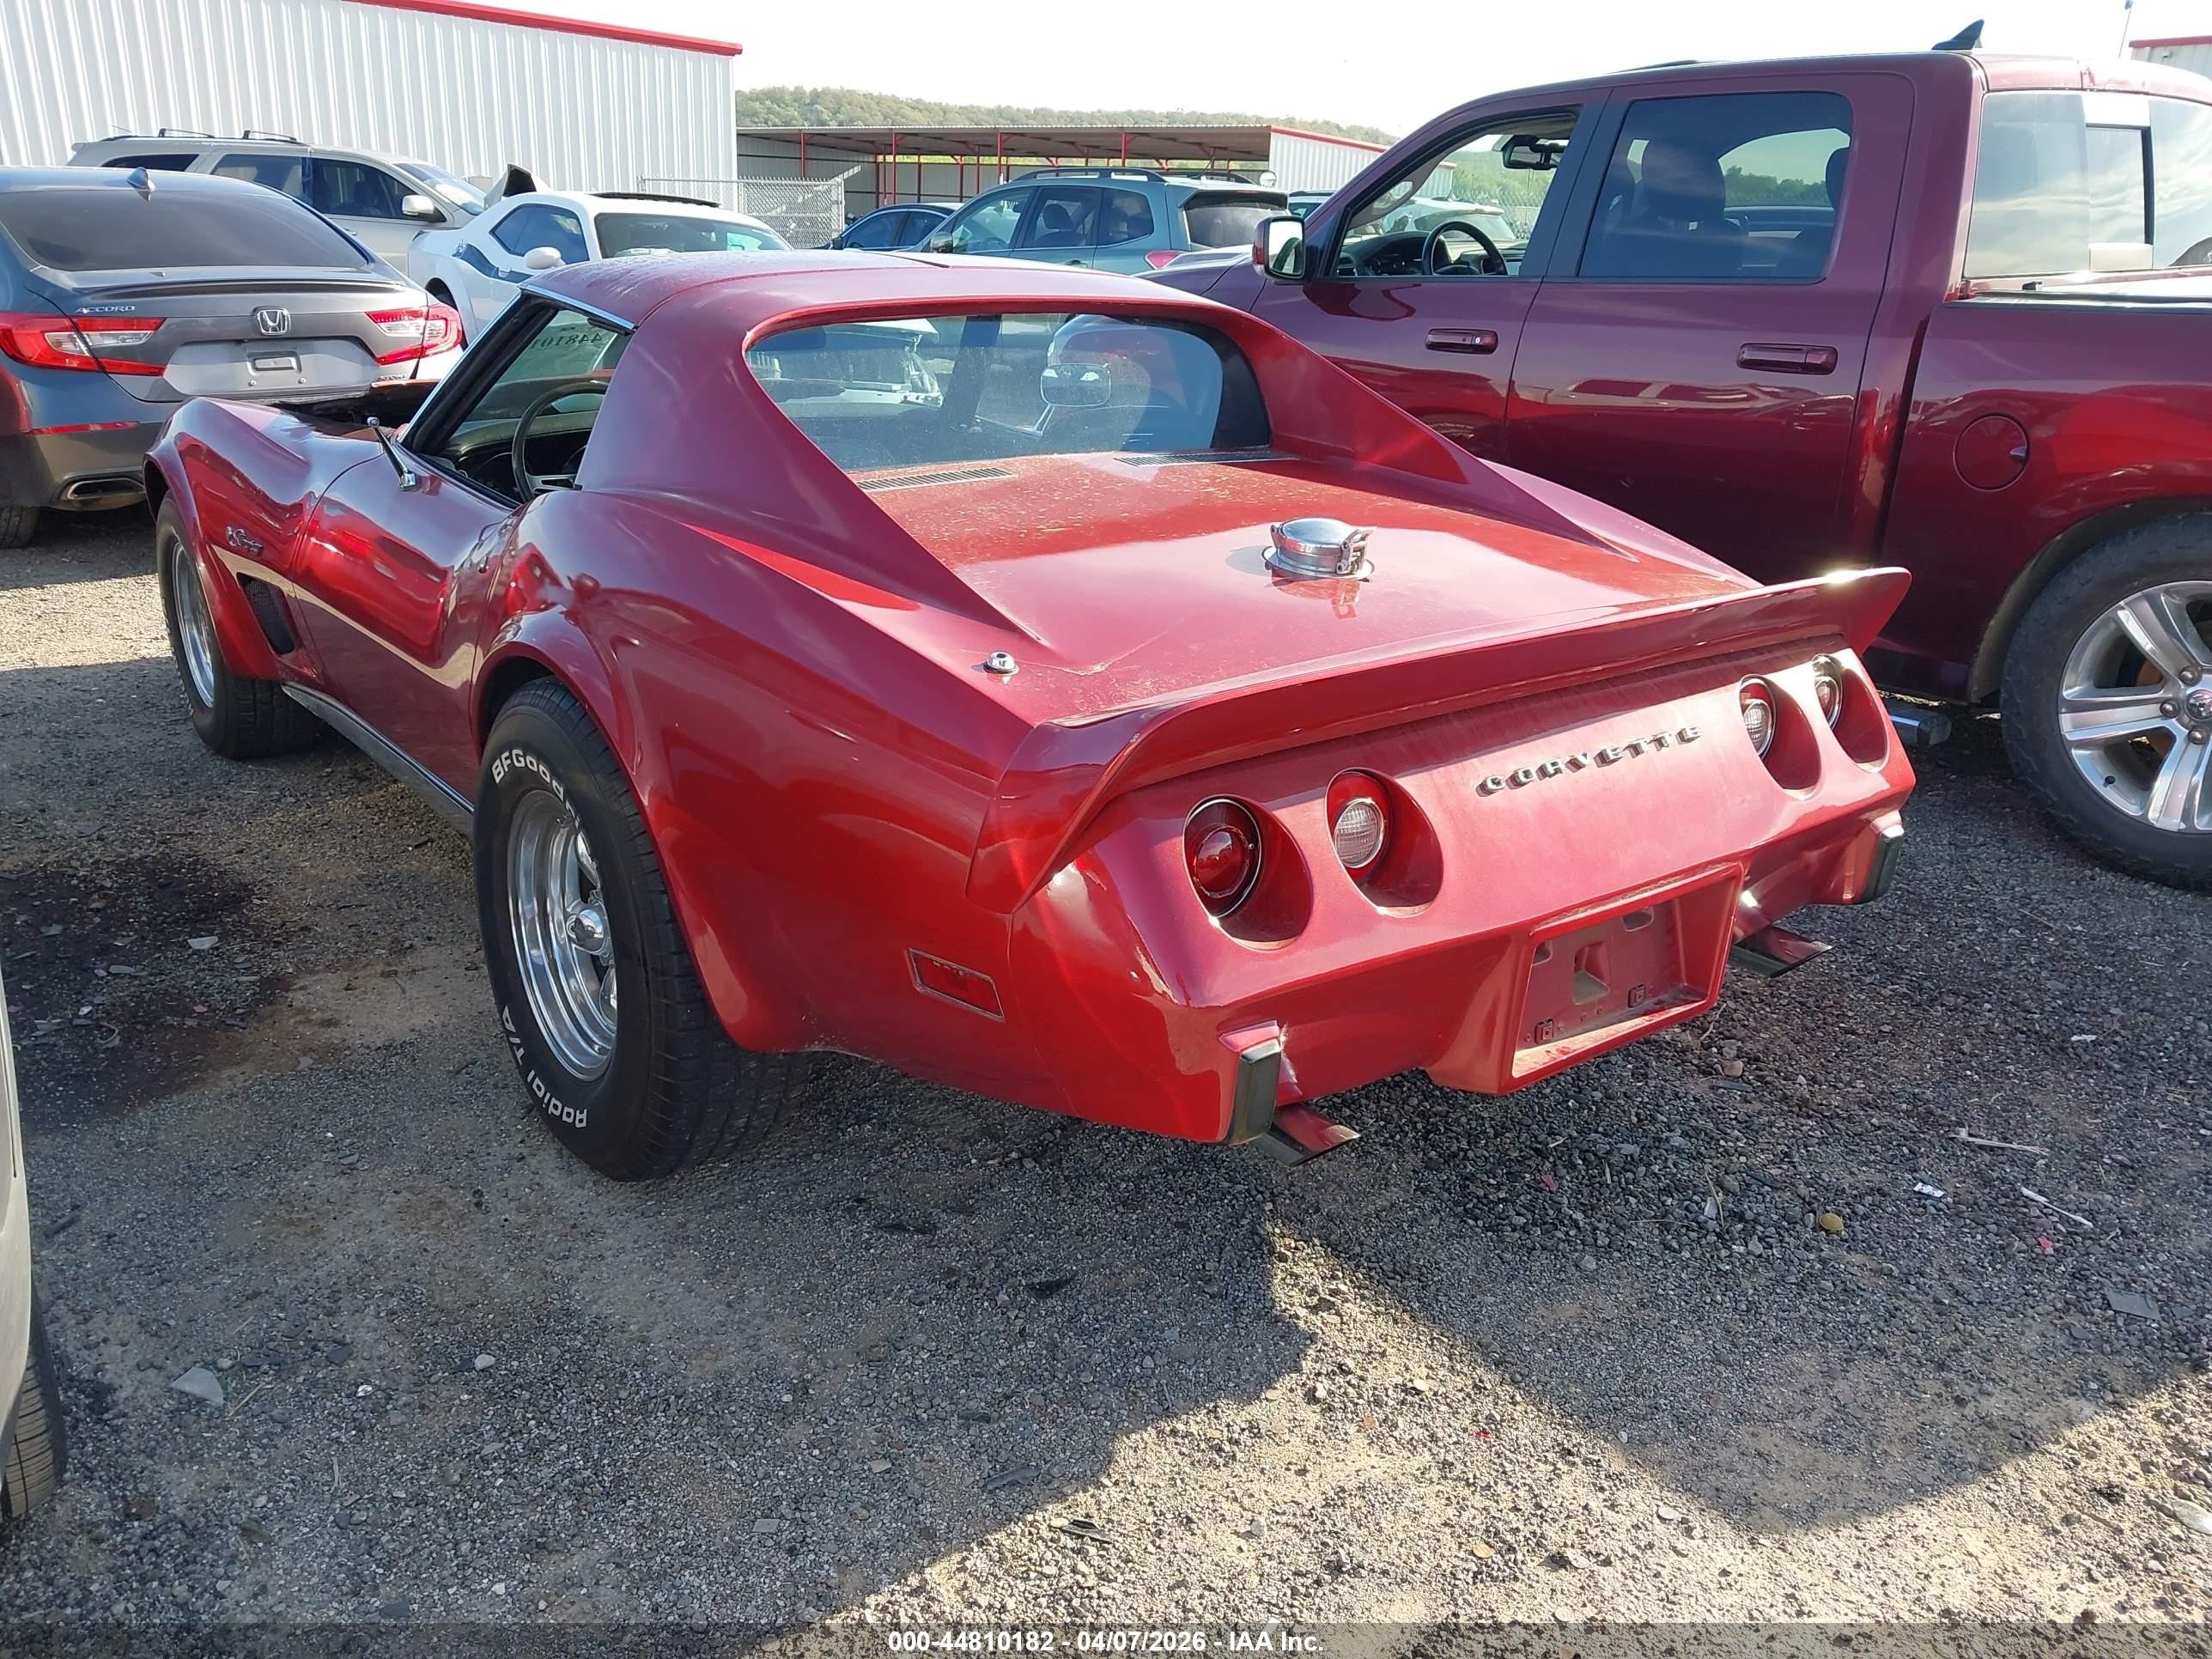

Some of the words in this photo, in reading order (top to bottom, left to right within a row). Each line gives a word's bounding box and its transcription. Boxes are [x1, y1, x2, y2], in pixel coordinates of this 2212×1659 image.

[75, 305, 136, 313] ACCORD
[1475, 726, 1702, 797] CORVETTE
[527, 1069, 587, 1128] Radial
